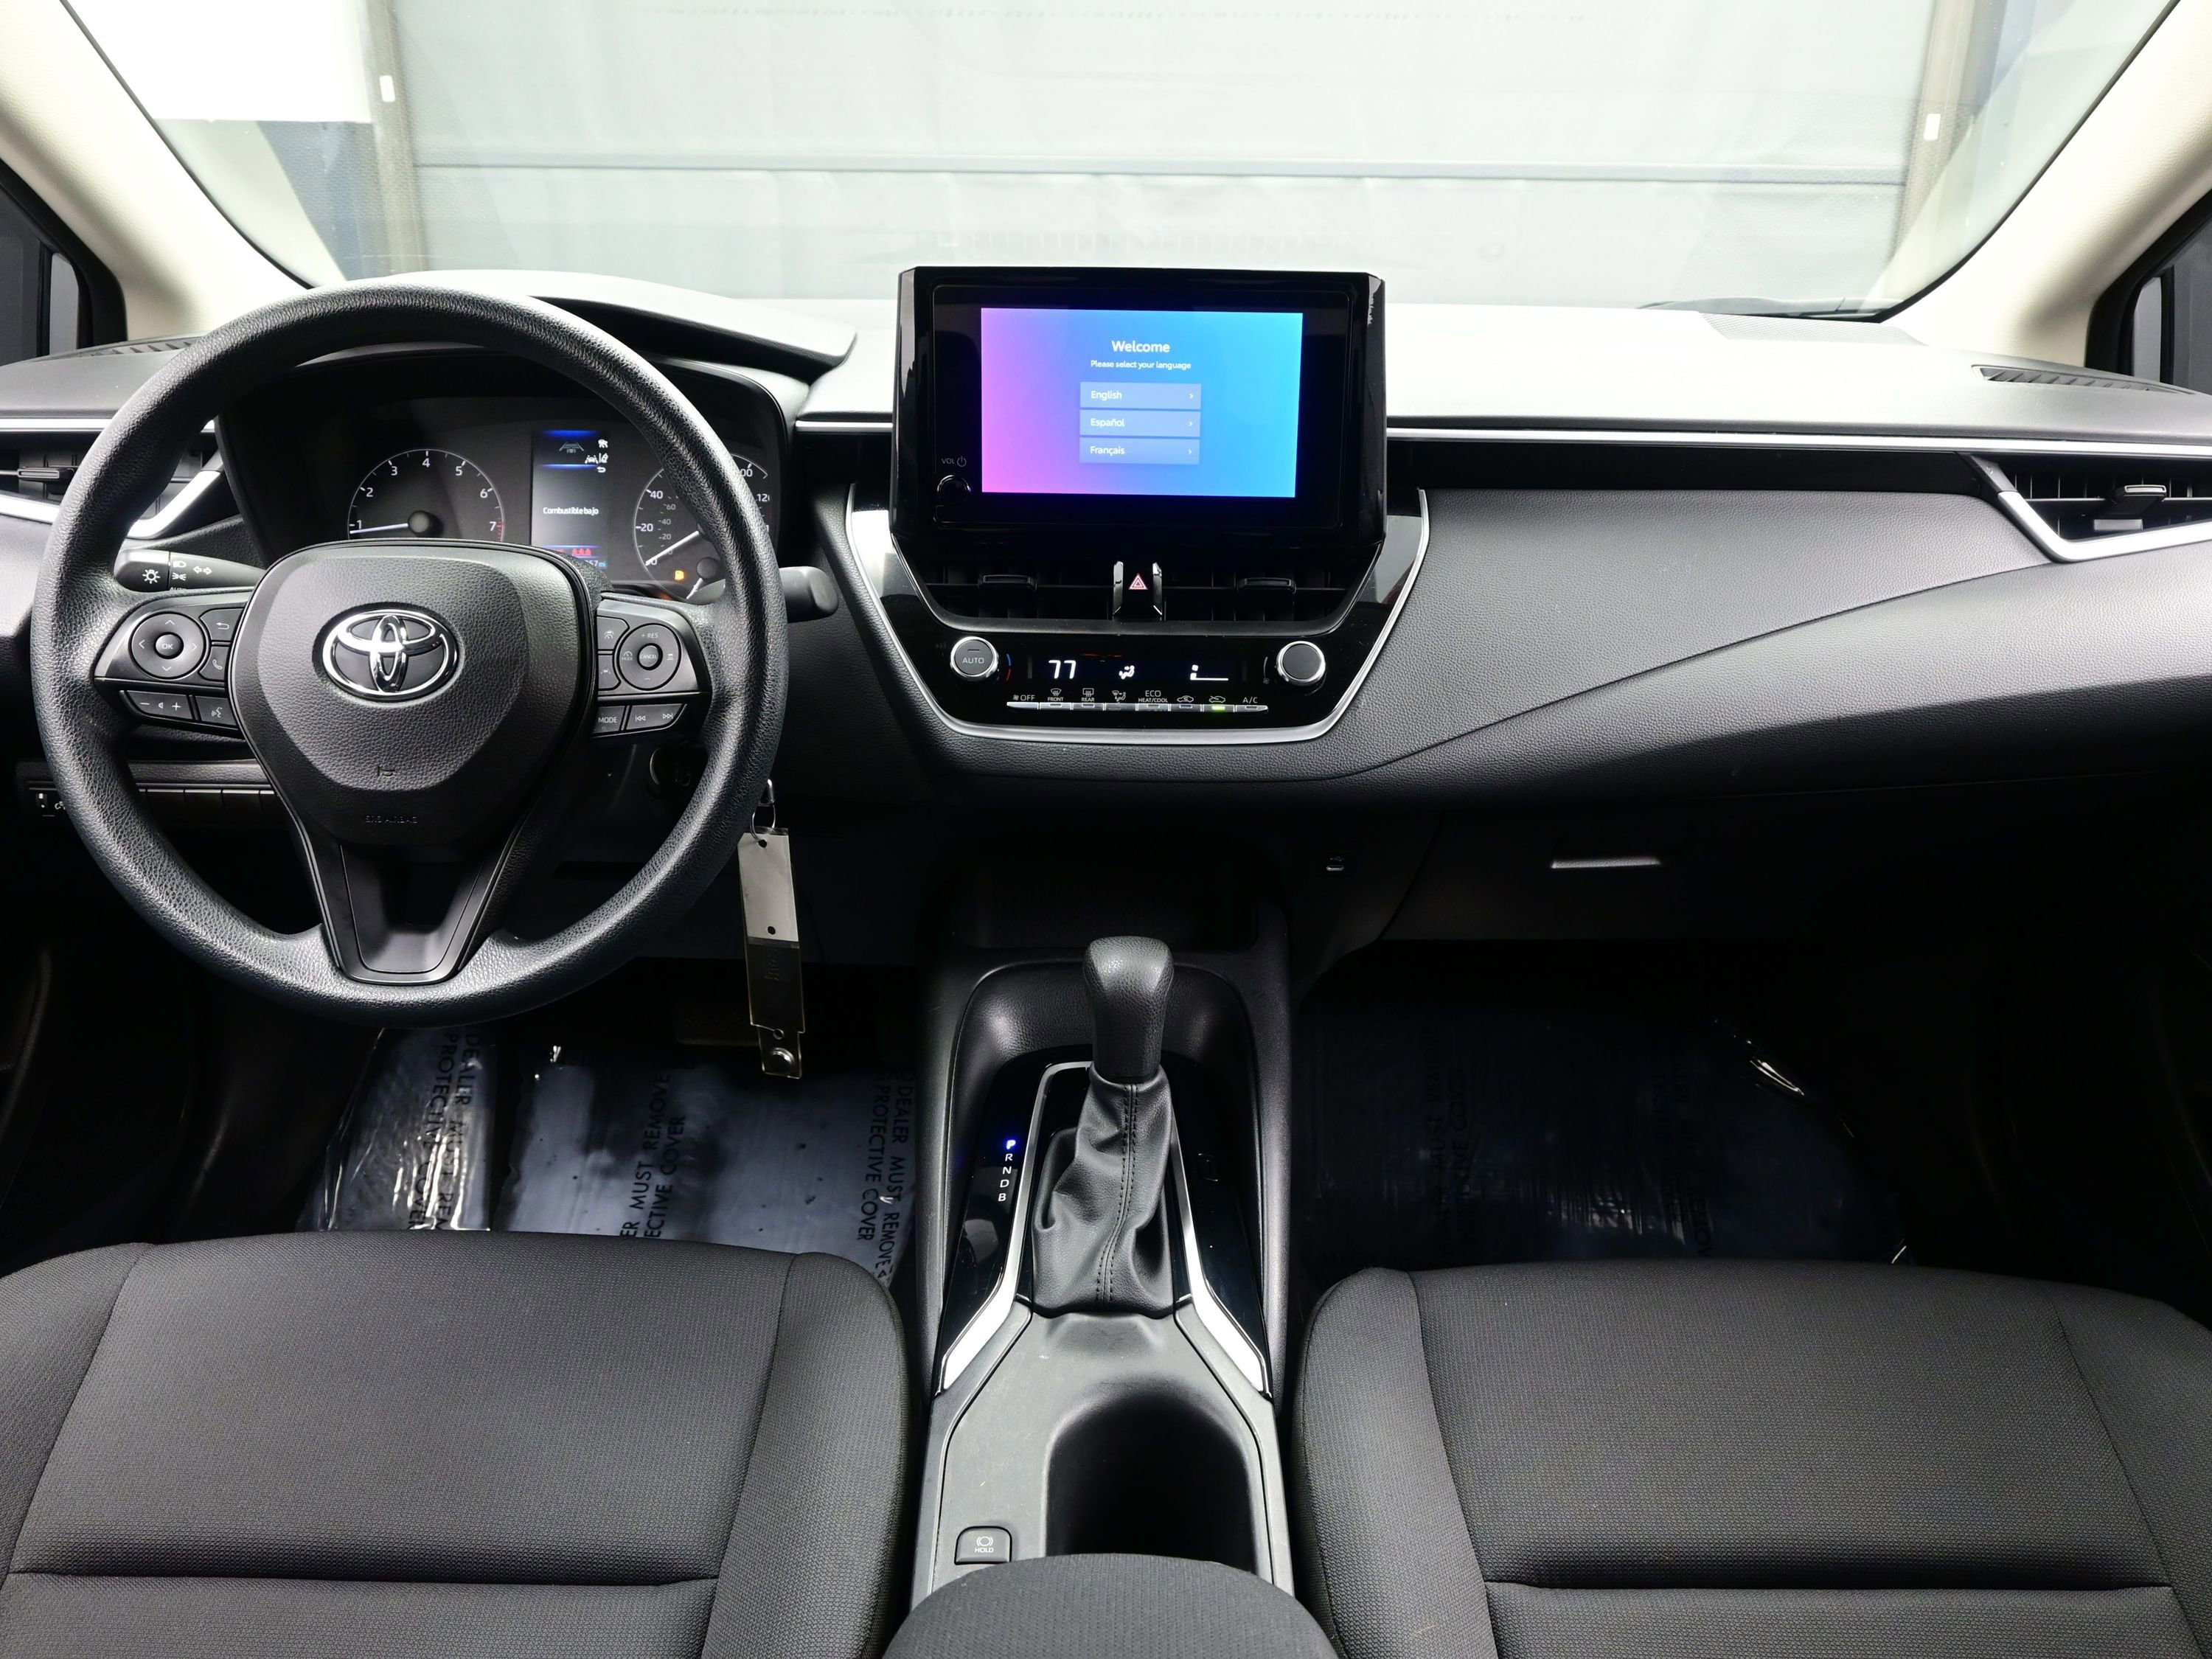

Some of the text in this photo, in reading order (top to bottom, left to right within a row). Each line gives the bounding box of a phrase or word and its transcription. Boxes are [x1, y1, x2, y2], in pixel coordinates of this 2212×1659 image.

[1111, 340, 1171, 353] Welcome
[1091, 360, 1192, 371] Please select your language
[1091, 391, 1122, 401] English
[1091, 418, 1125, 429] Español
[1090, 446, 1125, 456] Français
[422, 458, 431, 468] 4
[390, 466, 398, 476] 3
[454, 466, 463, 476] 5
[740, 468, 753, 478] 00
[366, 487, 374, 498] 2
[479, 488, 488, 498] 6
[650, 490, 664, 499] 40
[543, 507, 599, 515] Combustible bajo
[357, 519, 362, 530] 1
[488, 521, 497, 531] 7
[640, 523, 654, 532] 20
[1048, 659, 1077, 679] 77
[1242, 696, 1258, 704] A/C
[454, 1034, 481, 1106] DEALER
[642, 1074, 670, 1151] REMOVE
[891, 1085, 914, 1144] DEALER
[660, 1116, 686, 1175] COVER
[1006, 1139, 1016, 1150] P
[1005, 1153, 1013, 1161] R
[856, 1085, 891, 1240] PROTECTIVE COVER
[1002, 1166, 1012, 1175] N
[886, 1155, 906, 1202] MUST
[1000, 1179, 1009, 1188] D
[630, 1161, 655, 1211] MUST
[998, 1192, 1006, 1202] B
[875, 1212, 900, 1269] REMOVE
